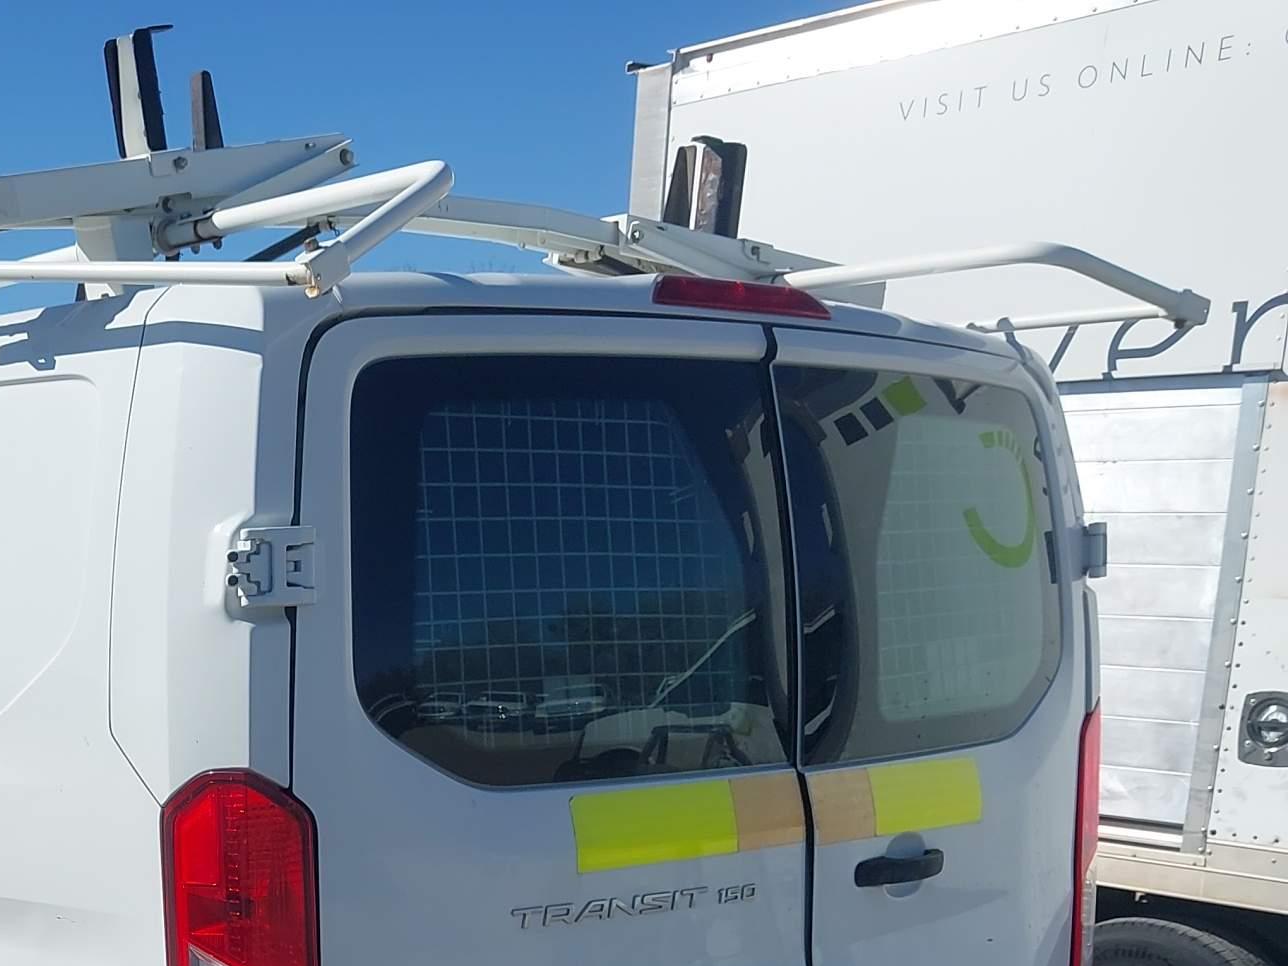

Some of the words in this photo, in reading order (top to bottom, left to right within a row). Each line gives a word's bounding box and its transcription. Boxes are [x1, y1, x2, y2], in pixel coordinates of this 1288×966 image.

[899, 86, 988, 121] VISIT
[1011, 74, 1052, 102] US
[1077, 35, 1252, 89] ONLINE:
[510, 886, 709, 930] TRANSIT
[717, 883, 756, 904] 150
